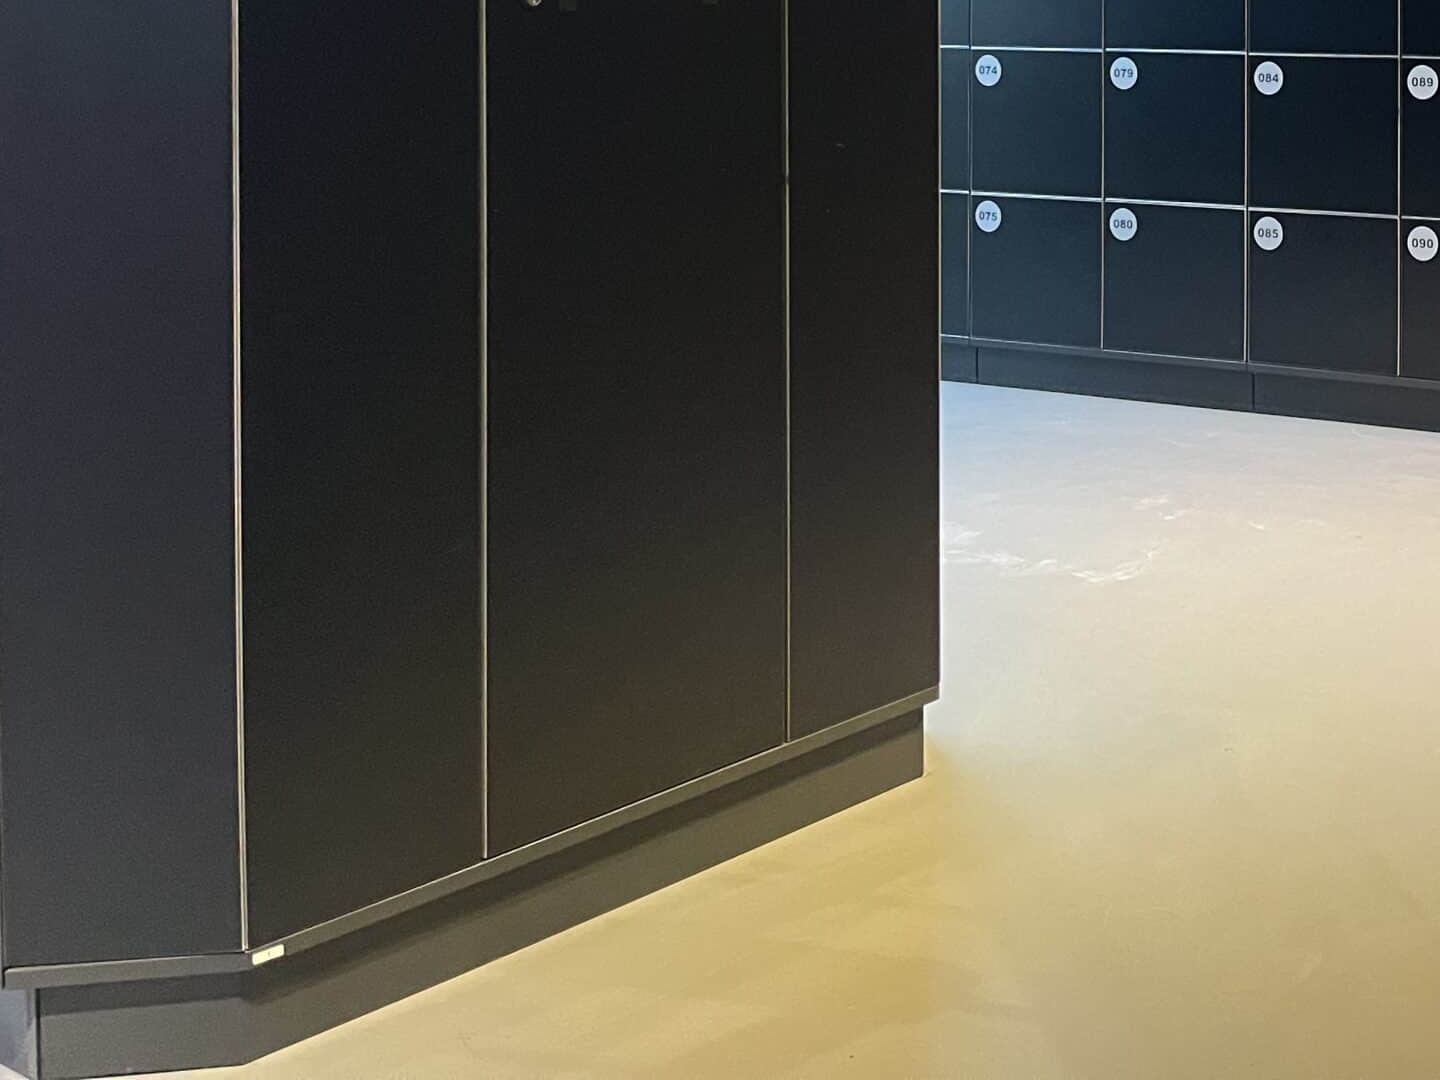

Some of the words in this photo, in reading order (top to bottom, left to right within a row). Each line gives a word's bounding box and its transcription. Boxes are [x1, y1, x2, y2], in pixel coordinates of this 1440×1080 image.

[978, 64, 998, 75] 074
[1113, 67, 1134, 78] 079
[1257, 72, 1279, 83] 084
[1412, 76, 1434, 88] 089
[978, 210, 998, 221] 075
[1113, 219, 1134, 230] 080
[1257, 227, 1279, 239] 085
[1412, 237, 1434, 249] 090
